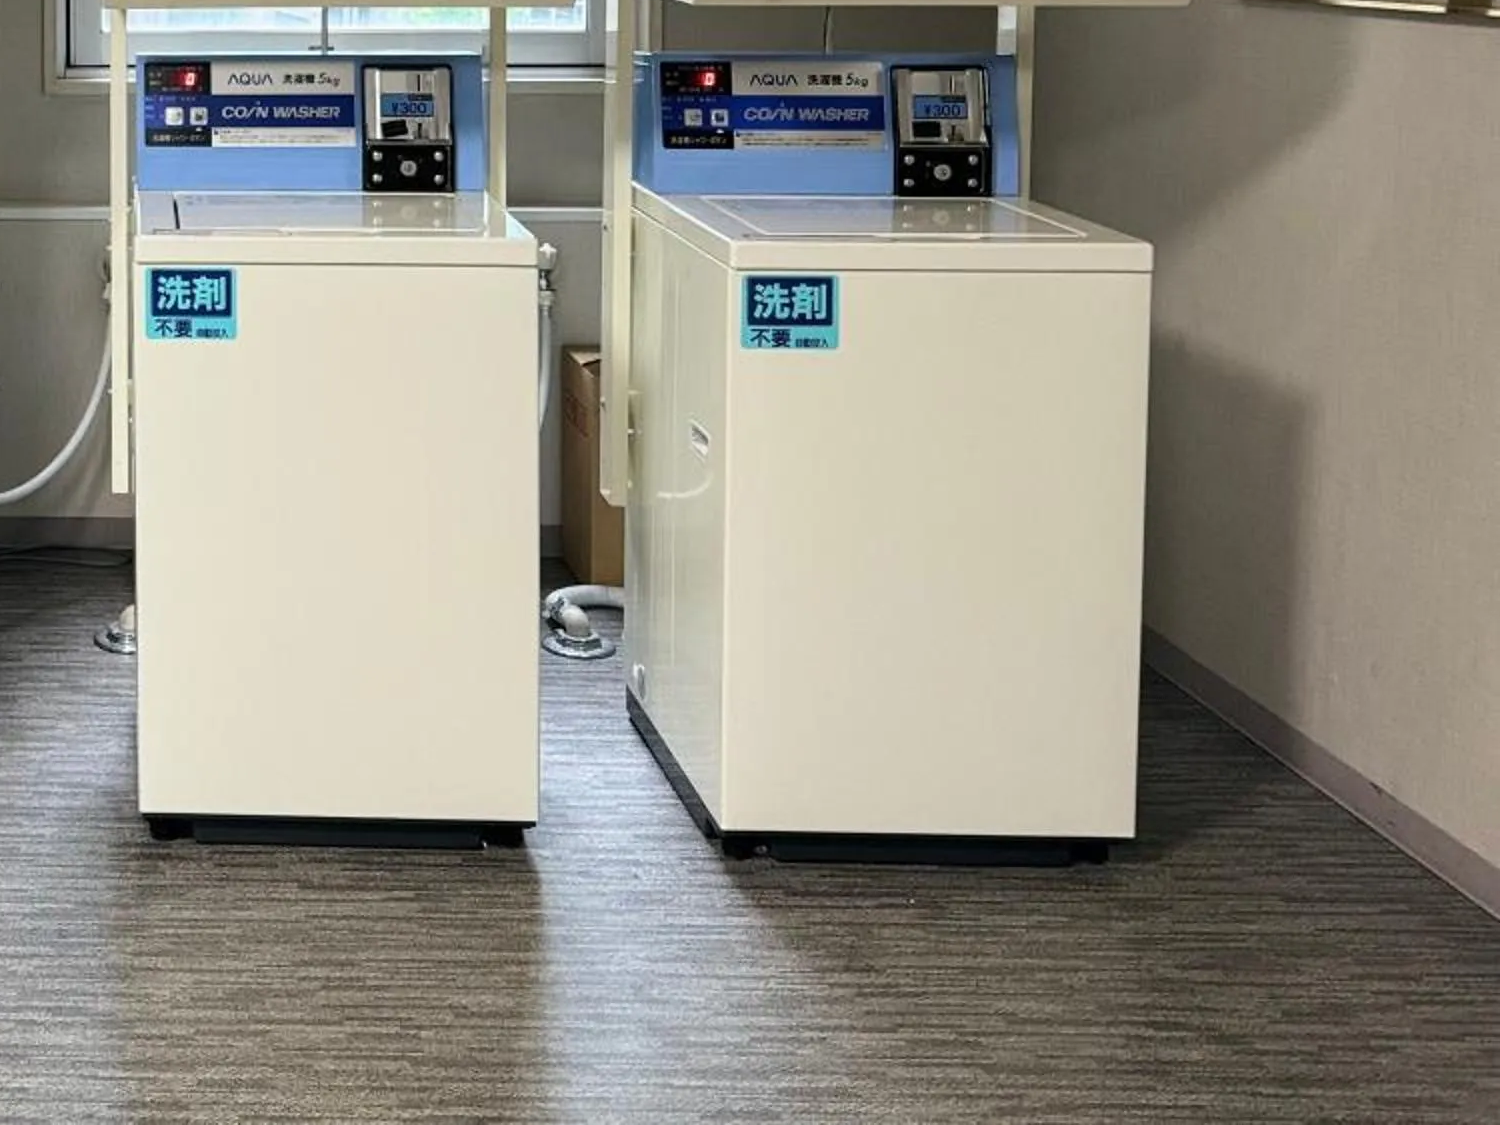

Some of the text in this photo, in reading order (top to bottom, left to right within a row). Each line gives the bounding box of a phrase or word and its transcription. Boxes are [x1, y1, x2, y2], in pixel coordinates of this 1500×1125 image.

[227, 73, 274, 87] AQUA
[317, 72, 341, 87] 5kg
[750, 74, 798, 87] AQUA
[845, 72, 869, 88] 5kg
[273, 105, 341, 119] WASHER
[798, 107, 871, 122] WASHER
[157, 274, 227, 312] 洗剤
[753, 282, 827, 321] 洗剤
[154, 318, 192, 338] 不要
[749, 328, 791, 348] 不要
